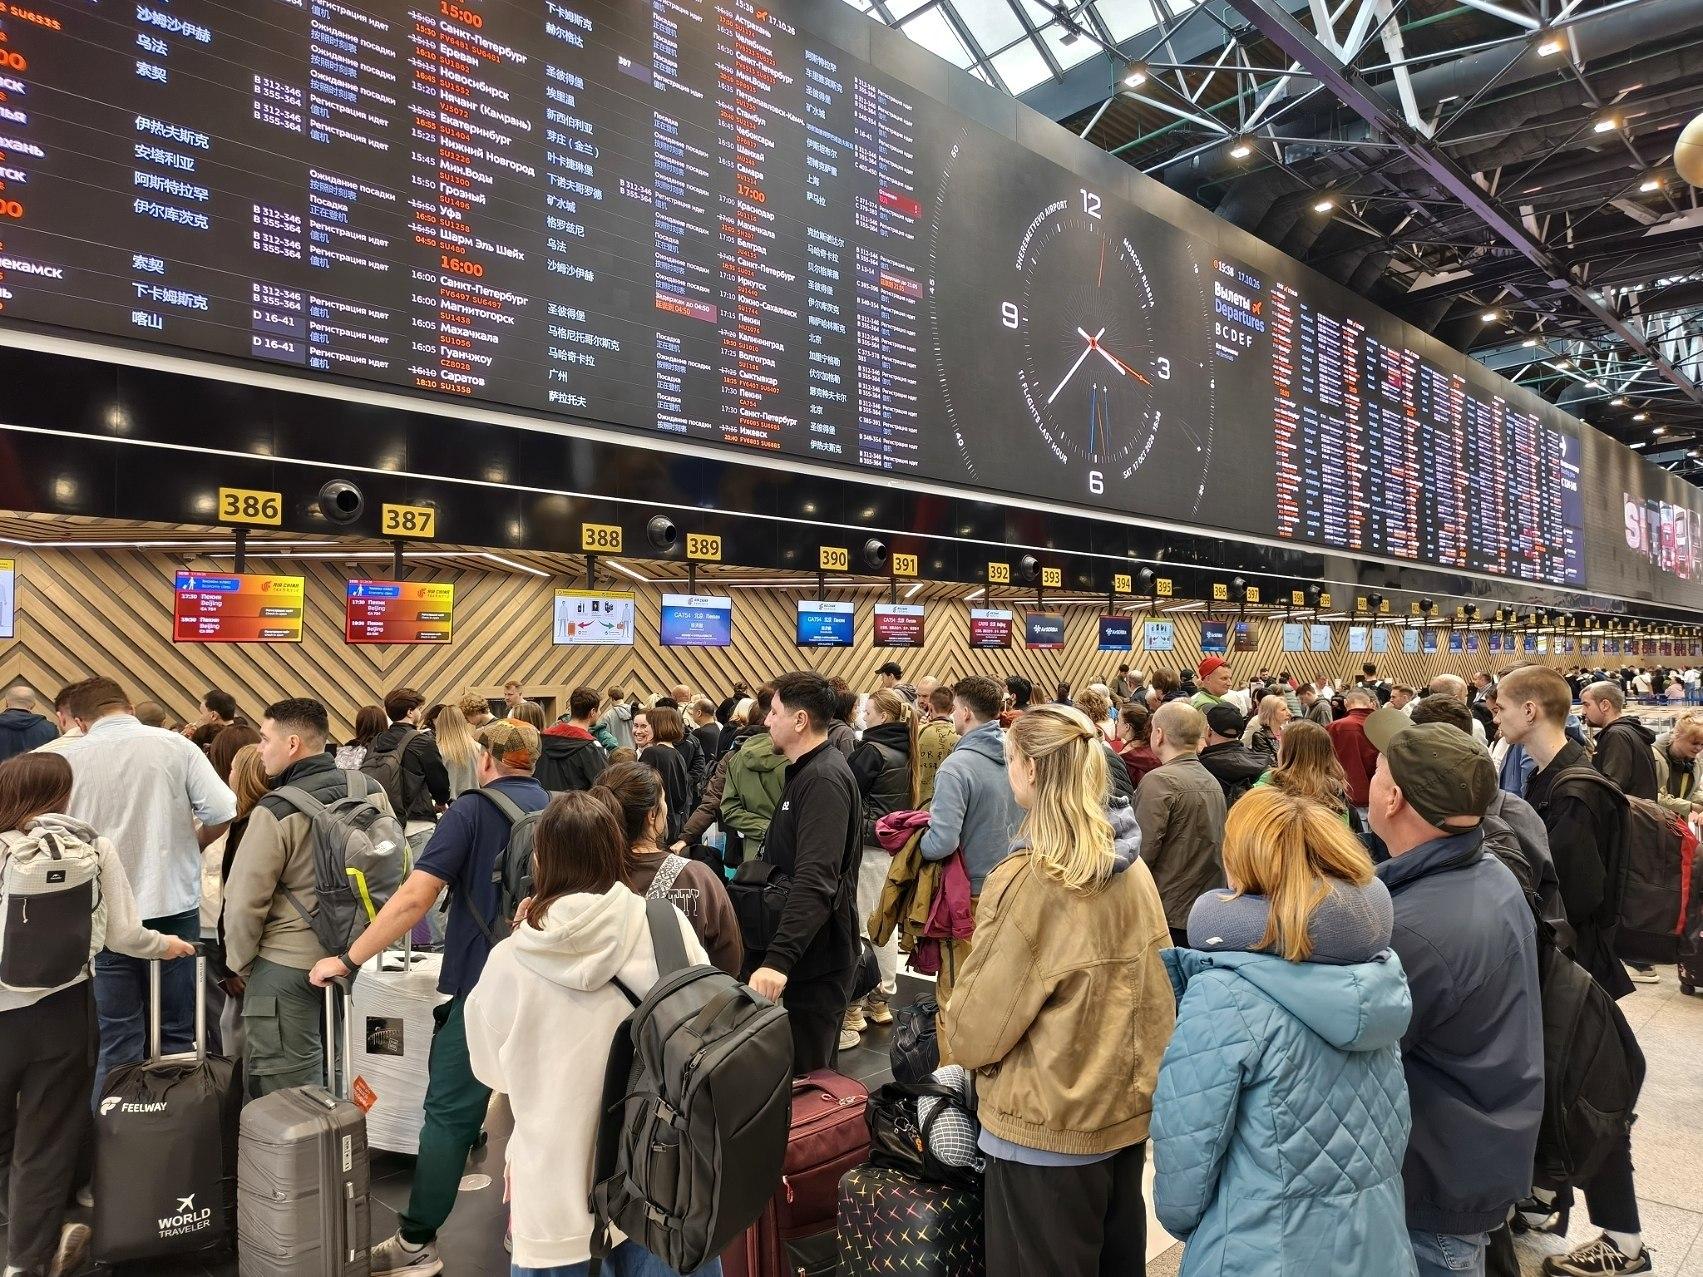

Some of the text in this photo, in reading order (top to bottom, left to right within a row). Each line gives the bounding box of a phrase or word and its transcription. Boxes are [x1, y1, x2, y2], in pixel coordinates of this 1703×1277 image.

[440, 2, 483, 29] 15:00
[736, 0, 754, 13] 15:38
[136, 5, 211, 44] 沙姆沙伊赫
[137, 34, 168, 56] 乌法
[311, 20, 396, 57] Ожидание посадки
[441, 20, 528, 64] Санкт-Петербург
[311, 45, 396, 82] Ожидание посадки
[441, 43, 479, 67] Ереван
[136, 61, 167, 83] 索契
[254, 75, 301, 97] B 312-346
[310, 69, 396, 105] Ожидание посадки
[441, 67, 510, 101] Новосибирск
[254, 85, 301, 107] B 355-364
[412, 81, 532, 131] 15:20 Нячанг (Камрань)
[254, 101, 301, 123] B 312-346
[254, 111, 301, 132] B 355-364
[135, 115, 209, 150] 伊热夫斯克
[441, 114, 512, 146] Екатеринбург
[135, 144, 195, 172] 安塔利亚
[412, 128, 535, 177] 15:25 Нижний Новгород
[411, 152, 493, 185] 15:45 Мин.Воды
[135, 170, 209, 201] 阿斯特拉罕
[310, 170, 396, 201] Ожидание посадки
[412, 175, 486, 204] 15:50 Грозный
[737, 184, 765, 203] 17:00
[134, 199, 209, 230] 伊尔库茨克
[254, 205, 301, 224] B 312-346
[310, 195, 348, 212] Посадка
[440, 205, 462, 220] Уфа
[1080, 189, 1102, 219] 12
[254, 215, 301, 234] B 355-364
[1016, 200, 1068, 270] SHEREMETYEVO AIRPORT
[254, 231, 301, 249] B 312-346
[254, 241, 301, 259] B 355-364
[440, 229, 525, 261] Шарм Эль Шейх
[547, 238, 567, 254] 乌法
[132, 255, 164, 274] 索契
[441, 255, 483, 277] 16:00
[1123, 238, 1144, 273] MOSCOW
[738, 257, 796, 281] Санкт-Петербург
[132, 282, 208, 310] 下卡姆斯克
[254, 284, 301, 300] B 312-346
[412, 271, 528, 306] 16:00 Санкт-Петербург
[1215, 281, 1250, 310] Вылеты
[254, 293, 301, 310] B 355-364
[310, 296, 366, 316] Регистрация
[412, 294, 515, 325] 16:00 Магнитогорск
[720, 291, 797, 318] 17:10 Южно-Сахалинск
[132, 311, 162, 329] 喀山
[254, 310, 294, 326] D 16-41
[548, 303, 586, 323] 圣彼得堡
[720, 310, 760, 326] 17:15 Пекин
[1002, 301, 1019, 329] 9
[1216, 297, 1265, 332] Departures
[412, 318, 499, 344] 16:05 Махачкала
[1216, 322, 1252, 347] B C D E F
[254, 336, 294, 352] D 16-41
[412, 342, 493, 366] 16:05 Гуанчжоу
[310, 347, 366, 365] Регистрация
[722, 348, 775, 367] 17:25 Волгоград
[441, 370, 486, 387] Саратов
[549, 369, 568, 383] 广州
[1157, 357, 1171, 380] 3
[721, 386, 762, 400] 17:30 Пекин
[721, 405, 797, 426] 17:30 Санкт-Петербург
[1019, 370, 1067, 464] 11 FLIGHTS LAST HOUR
[740, 427, 768, 438] Ижевск
[1123, 467, 1132, 479] SAT
[1133, 461, 1139, 471] 17
[1138, 450, 1146, 463] OCT
[1089, 471, 1104, 495] 6
[224, 493, 278, 520] 386
[386, 508, 432, 532] 387
[585, 529, 620, 549] 388
[689, 538, 719, 557] 389
[822, 551, 847, 567] 390
[895, 557, 917, 573] 391
[990, 566, 1008, 580] 392
[1044, 570, 1060, 584] 393
[1116, 578, 1130, 589] 394
[1158, 583, 1171, 592] 395
[1215, 587, 1227, 596] 396
[1248, 590, 1258, 599] 397
[121, 1102, 167, 1112] FEELWAY
[158, 1208, 211, 1230] WORLD
[159, 1219, 210, 1238] TRAVELER
